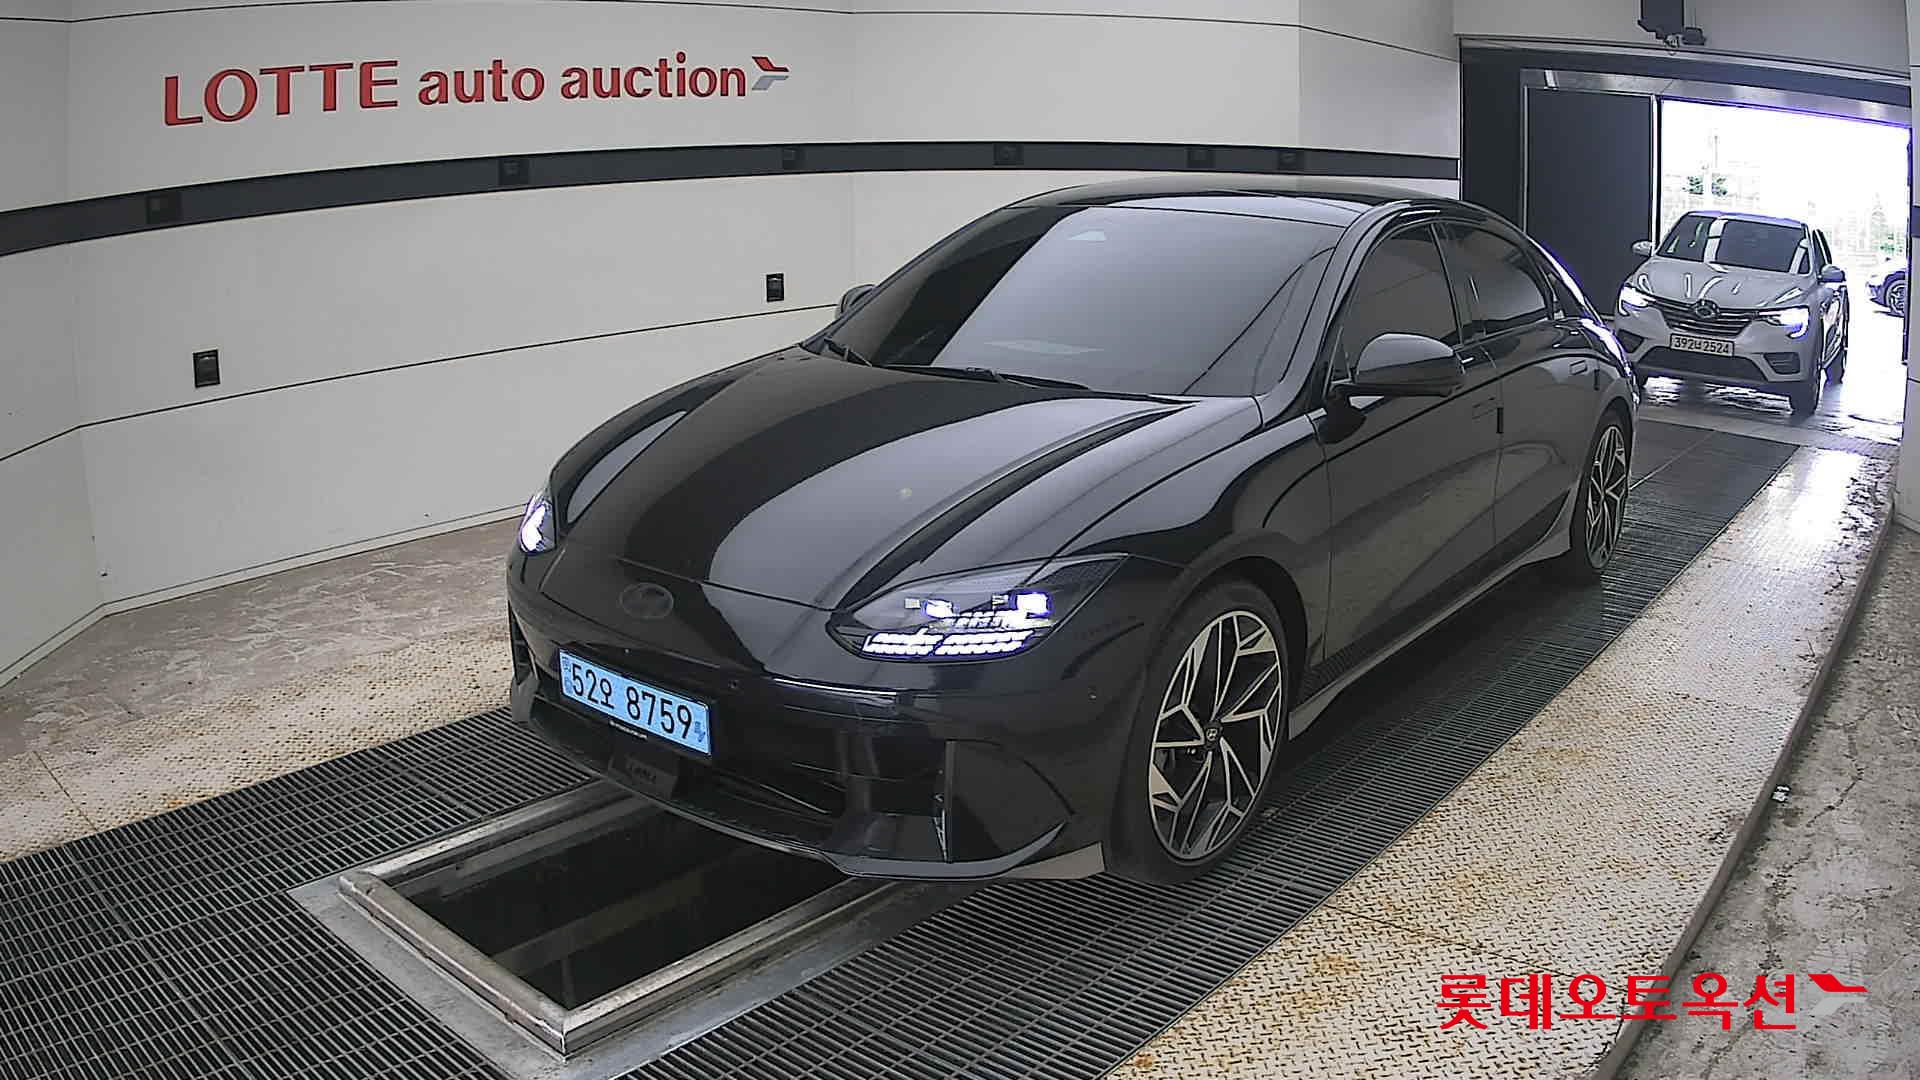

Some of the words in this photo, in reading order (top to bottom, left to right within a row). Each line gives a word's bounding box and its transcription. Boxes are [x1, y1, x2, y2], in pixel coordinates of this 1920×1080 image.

[163, 60, 399, 127] LOTTE
[417, 59, 546, 106] auto
[560, 51, 748, 99] auction
[1702, 341, 1728, 353] 2524
[572, 663, 615, 710] 52오
[626, 686, 692, 740] 8759
